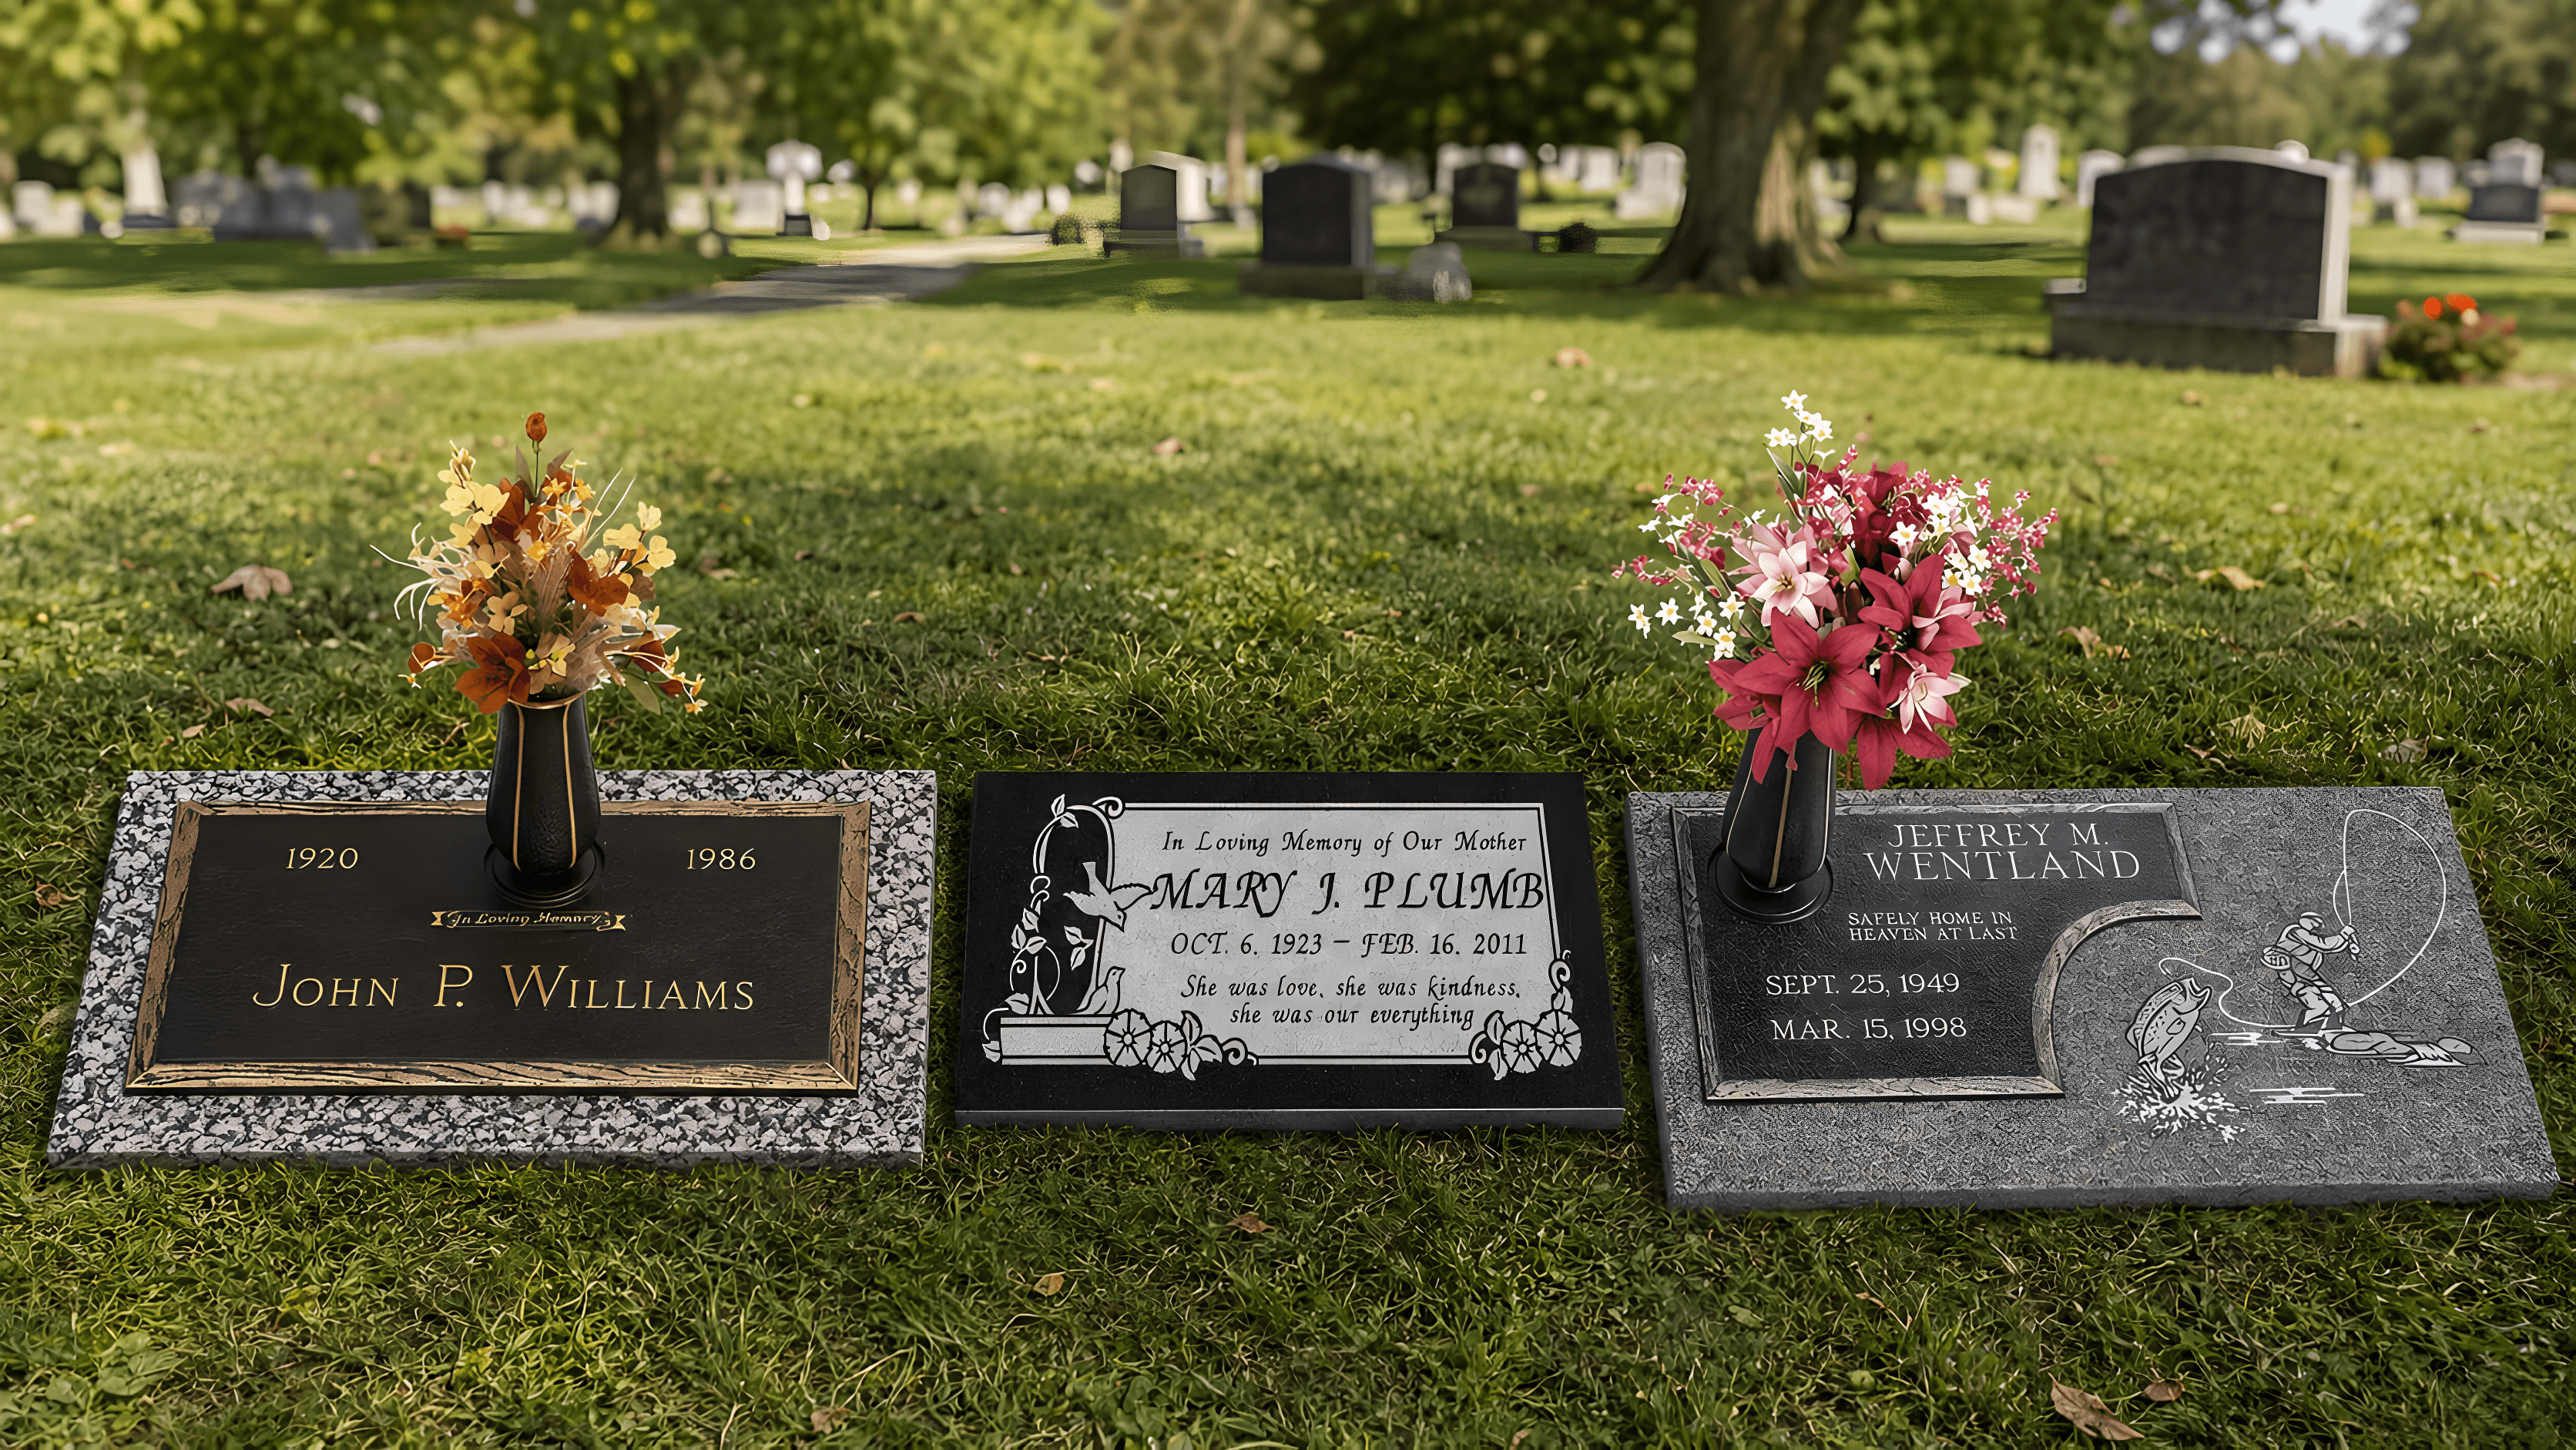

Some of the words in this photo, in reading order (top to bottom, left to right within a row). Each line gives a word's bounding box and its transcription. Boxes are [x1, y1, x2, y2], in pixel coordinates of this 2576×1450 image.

[1162, 831, 1184, 851] In
[1195, 831, 1270, 857] Loving
[1282, 829, 1362, 857] Memory
[1374, 831, 1394, 858] of
[1404, 831, 1443, 851] Our
[1454, 830, 1527, 851] Mother
[1887, 824, 2050, 848] JEFFREY
[2071, 824, 2109, 846] M.
[286, 848, 359, 869] 1920
[687, 848, 756, 870] 1986
[1863, 851, 2140, 880] WENTLAND
[1151, 868, 1299, 918] MARY
[1312, 872, 1340, 915] J.
[1364, 868, 1545, 910] PLUMB
[447, 910, 471, 928] In
[1929, 911, 1984, 925] HOME
[1991, 911, 2012, 925] IN
[1171, 931, 1229, 955] OCT.
[1272, 933, 1322, 955] 1923
[1360, 932, 1418, 958] FEB.
[1473, 933, 1527, 955] 2011
[1850, 928, 1927, 941] HEAVEN
[1938, 928, 1962, 941] AT
[1969, 927, 2018, 940] LAST
[433, 964, 473, 1008] P.
[1181, 975, 1217, 997] She
[1229, 982, 1267, 996] was
[1336, 975, 1367, 996] she
[1377, 982, 1417, 996] was
[1766, 975, 1840, 995] SEPT.
[1850, 974, 1890, 997] 25,
[1899, 973, 1960, 994] 1949
[1230, 1002, 1261, 1023] she
[1273, 1009, 1313, 1023] was
[1325, 1009, 1359, 1023] our
[1370, 1003, 1474, 1030] everything
[1770, 1019, 1850, 1040] MAR.
[1863, 1019, 1894, 1042] 15,
[1905, 1017, 1967, 1039] 1998
